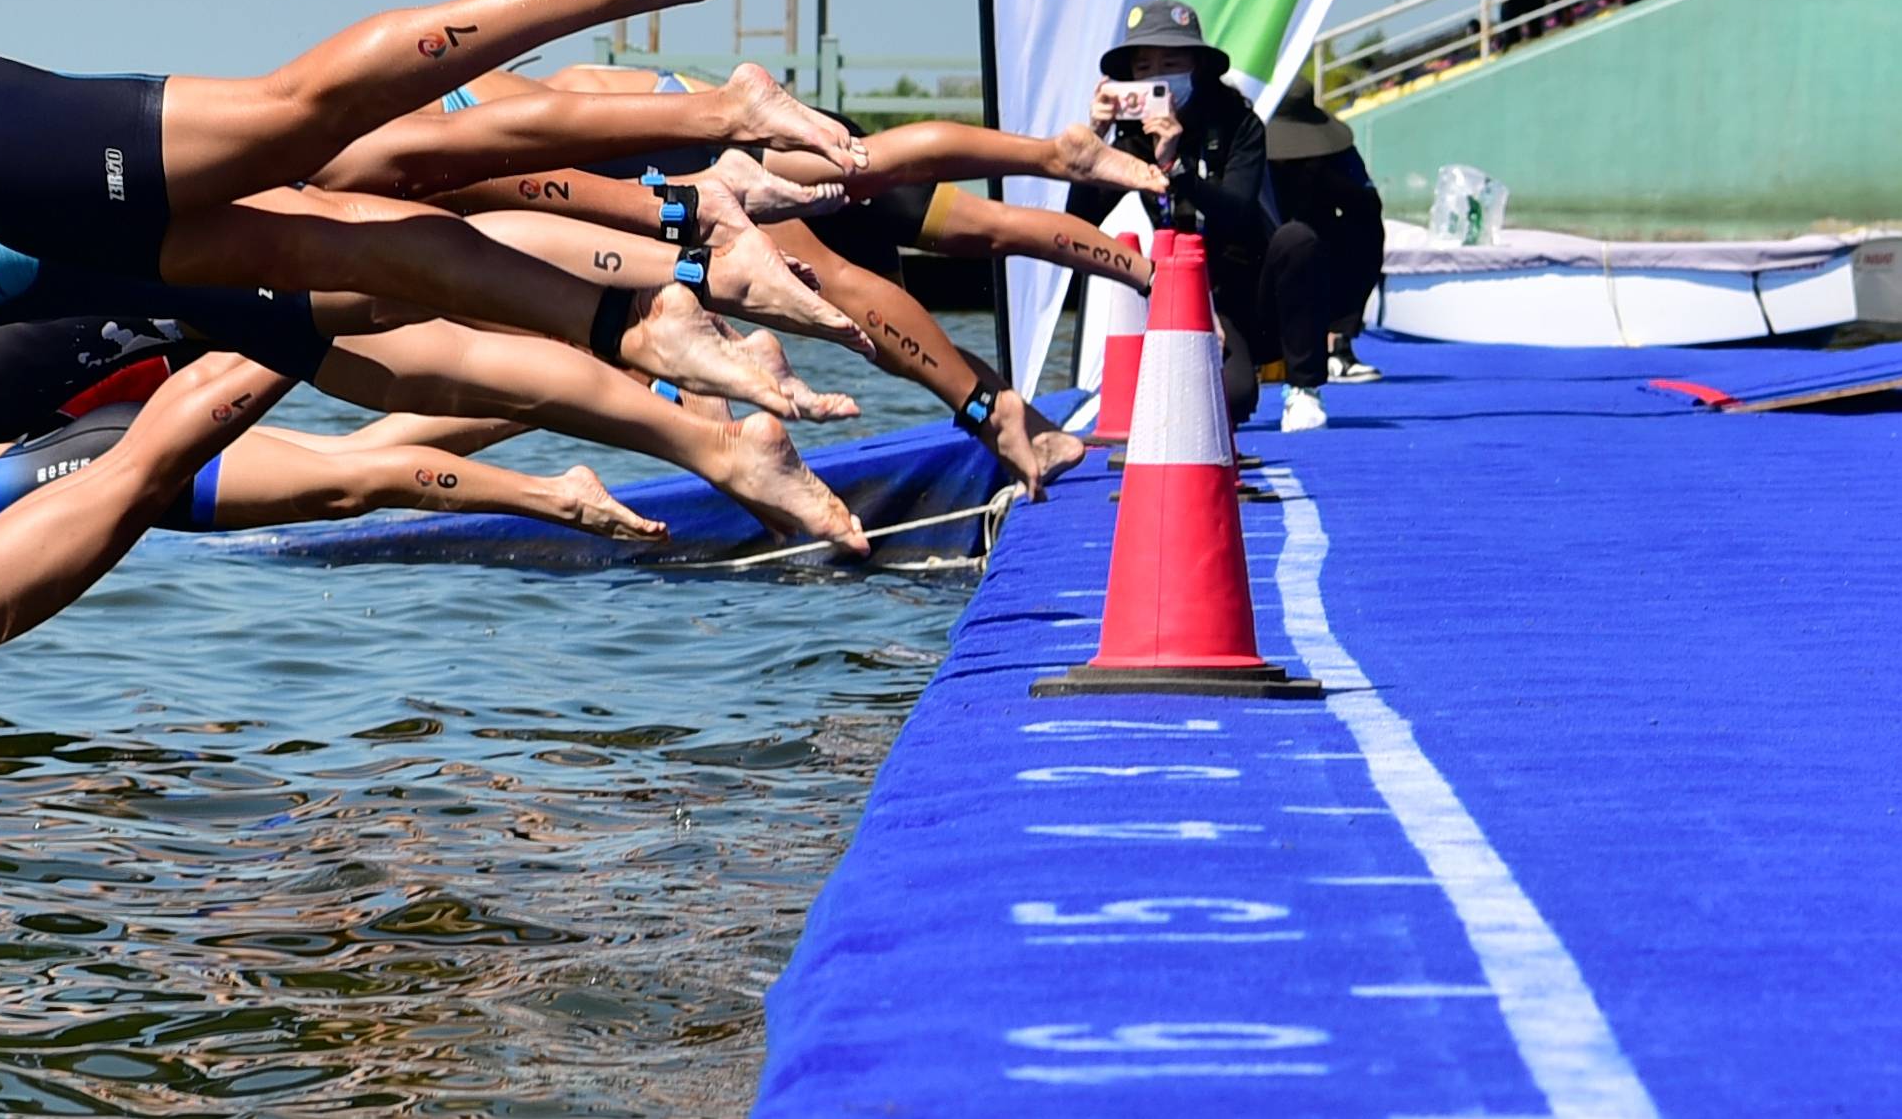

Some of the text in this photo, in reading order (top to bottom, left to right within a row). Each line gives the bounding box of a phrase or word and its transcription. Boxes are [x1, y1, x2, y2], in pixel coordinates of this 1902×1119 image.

[444, 25, 478, 48] 7
[544, 181, 569, 201] 2
[593, 250, 623, 273] 5
[1072, 239, 1132, 272] 132
[884, 323, 938, 369] 131
[437, 473, 458, 489] 6
